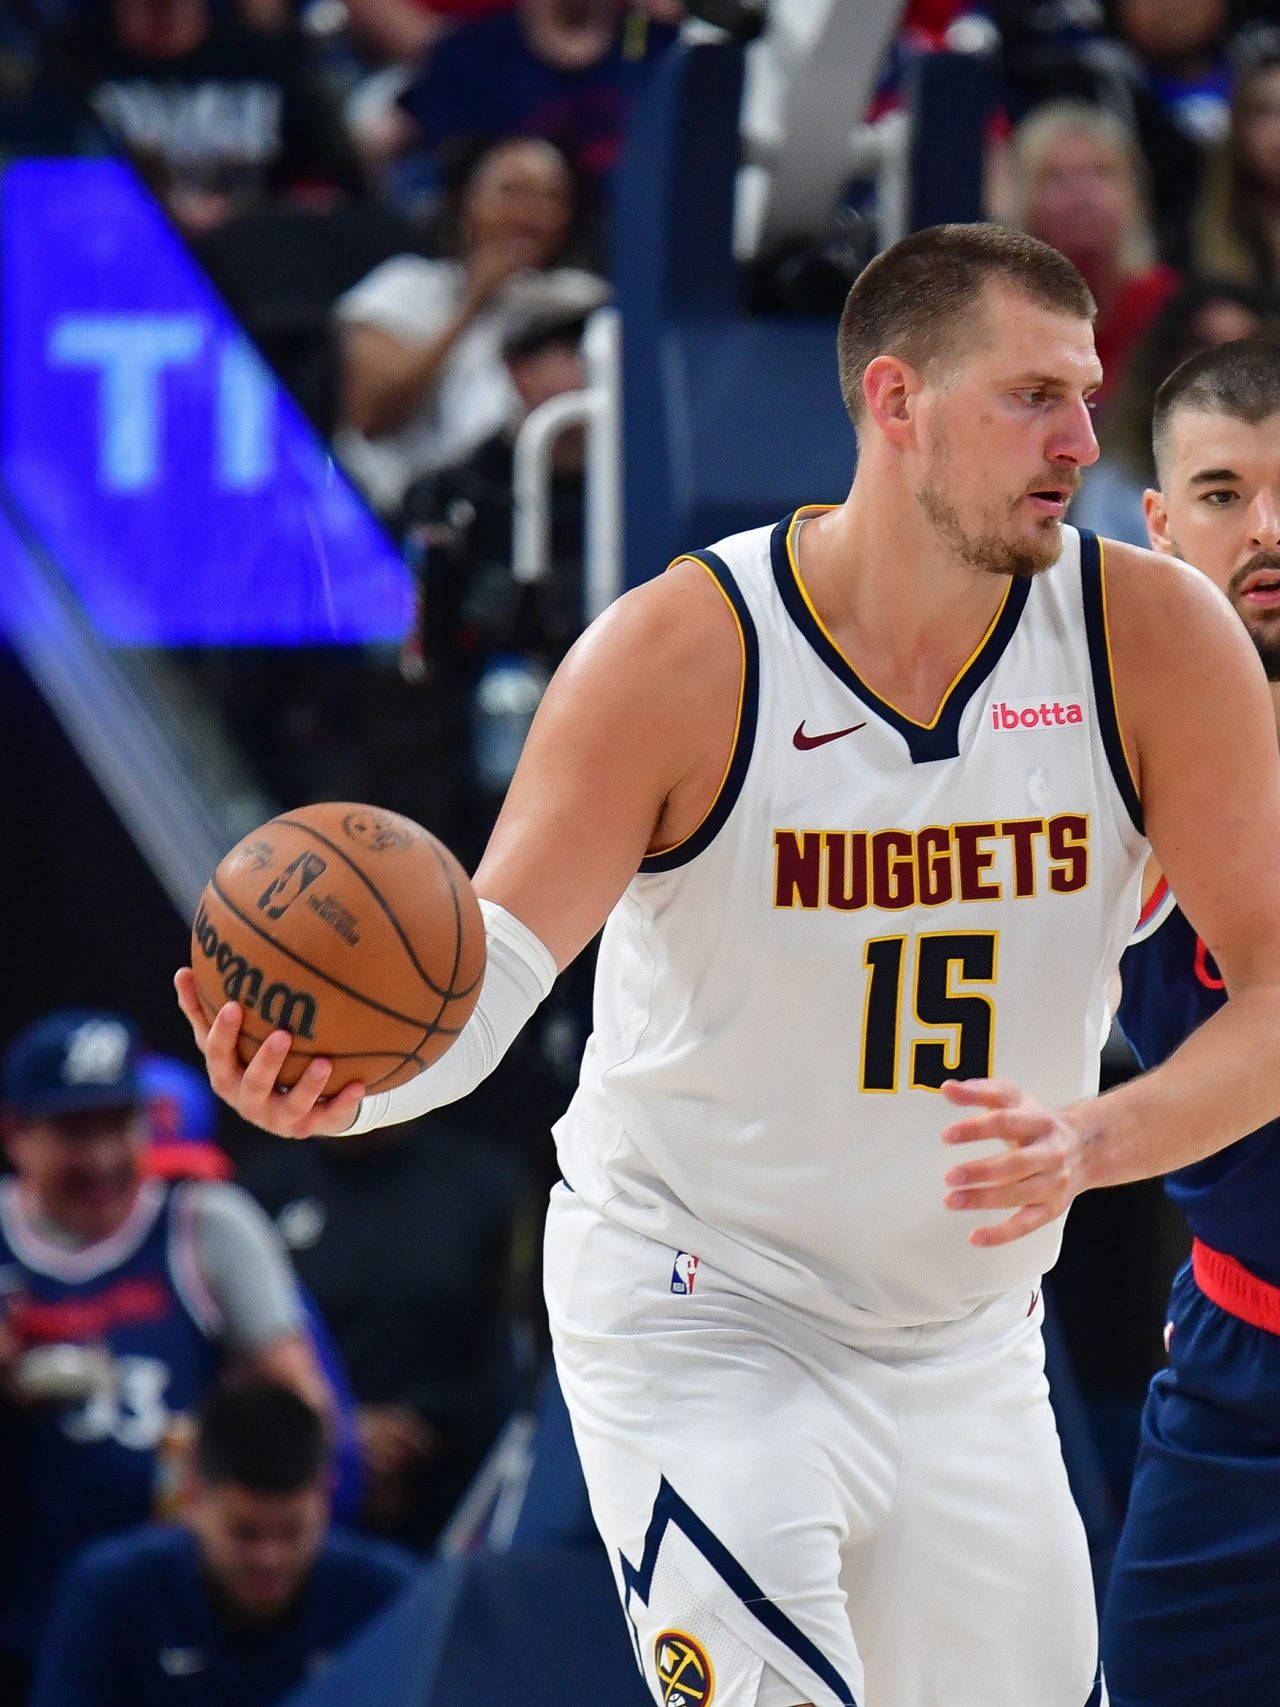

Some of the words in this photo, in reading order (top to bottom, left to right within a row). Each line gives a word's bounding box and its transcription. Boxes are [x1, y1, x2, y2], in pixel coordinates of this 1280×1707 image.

[991, 702, 1084, 730] ibotta
[772, 812, 1090, 912] NUGGETS
[858, 929, 1000, 1094] 15
